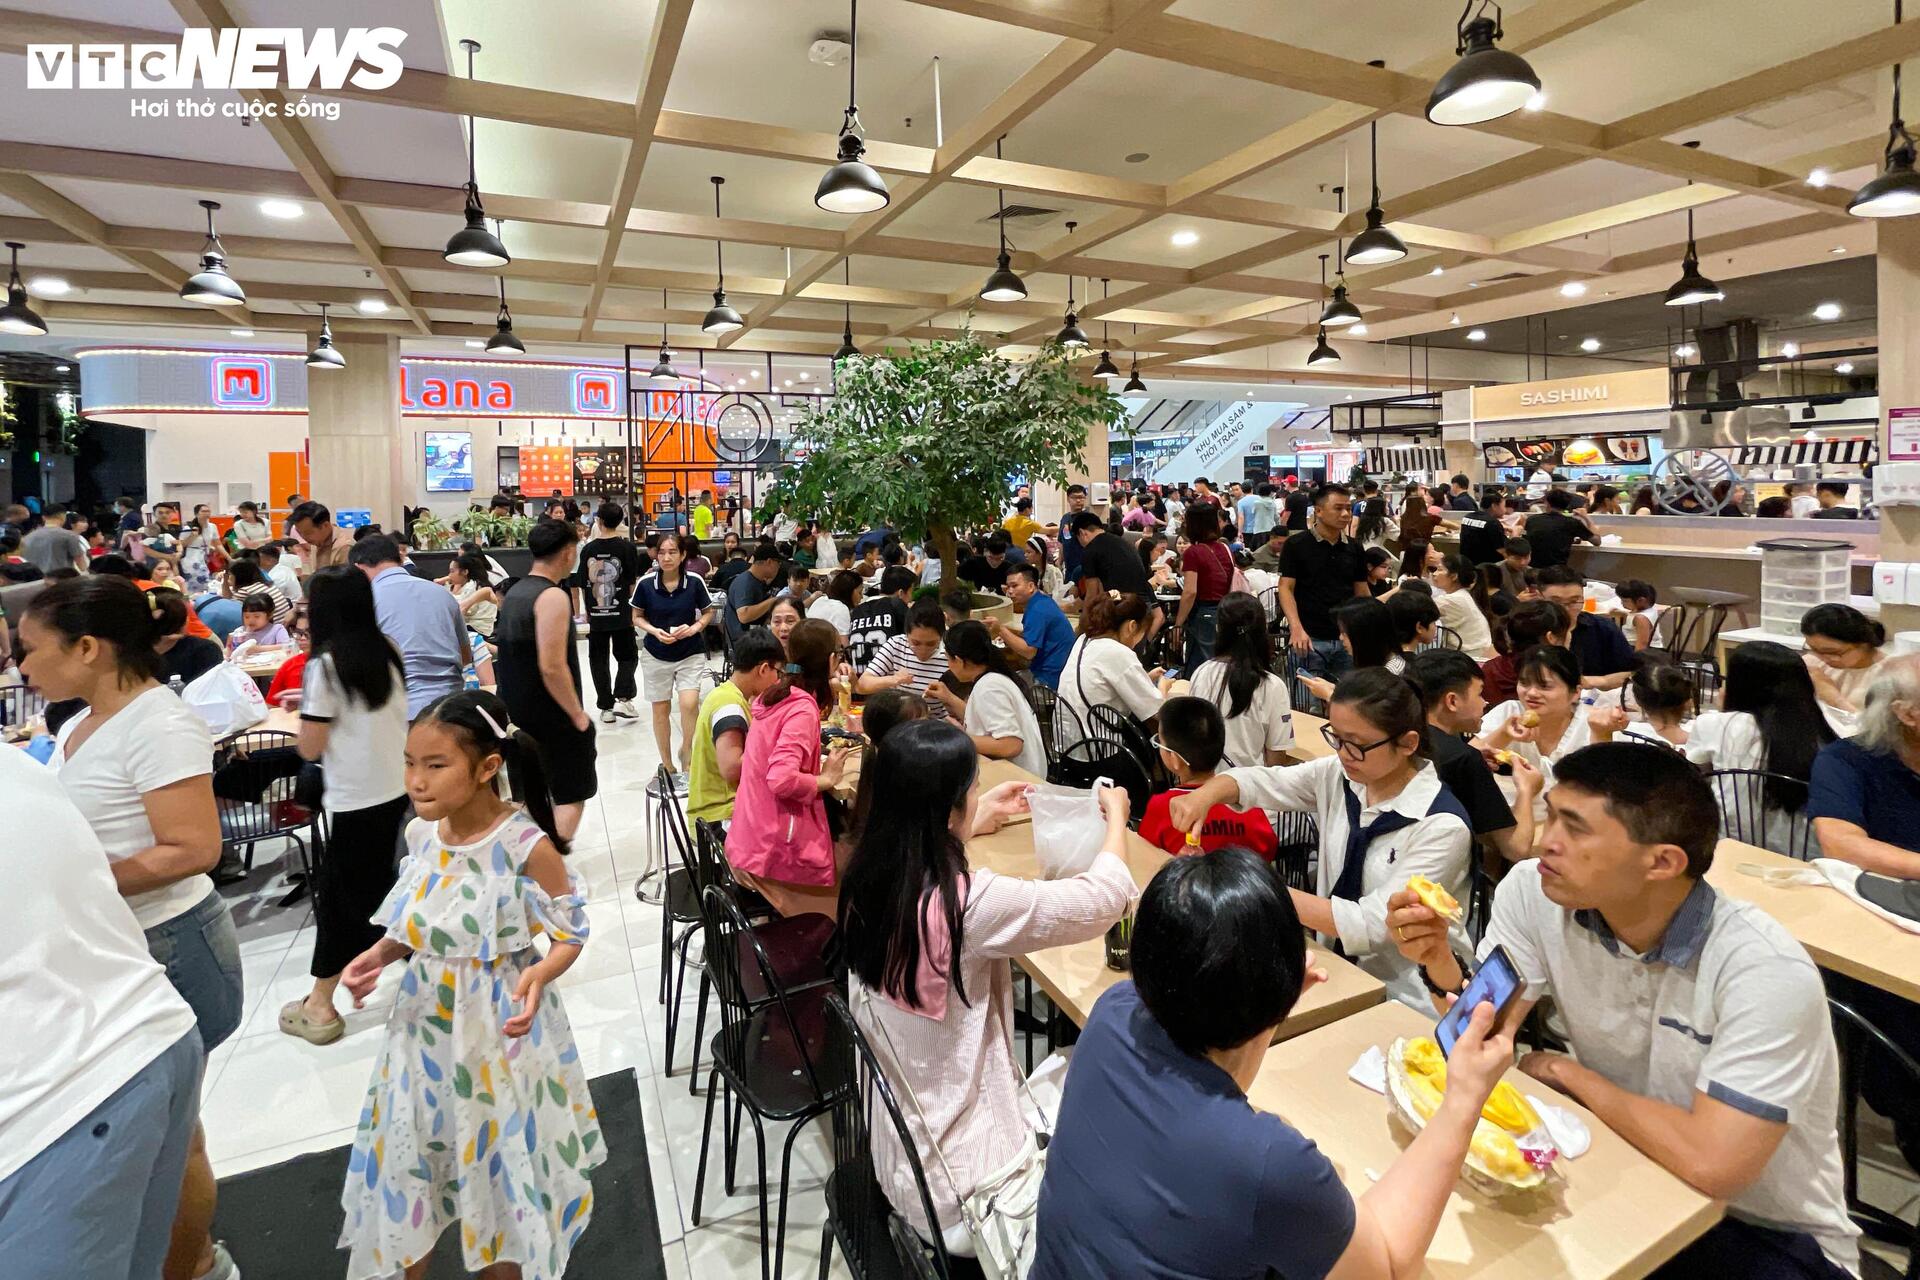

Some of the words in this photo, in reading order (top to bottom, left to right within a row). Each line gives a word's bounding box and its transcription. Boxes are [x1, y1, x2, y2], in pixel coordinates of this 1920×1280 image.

[400, 366, 514, 411] lana
[1519, 384, 1609, 407] SASHIMI
[1195, 436, 1211, 455] KHU
[1210, 422, 1229, 441] MUA
[1217, 421, 1245, 447] TRANG
[1252, 444, 1264, 452] ATM
[850, 613, 892, 631] EELAB
